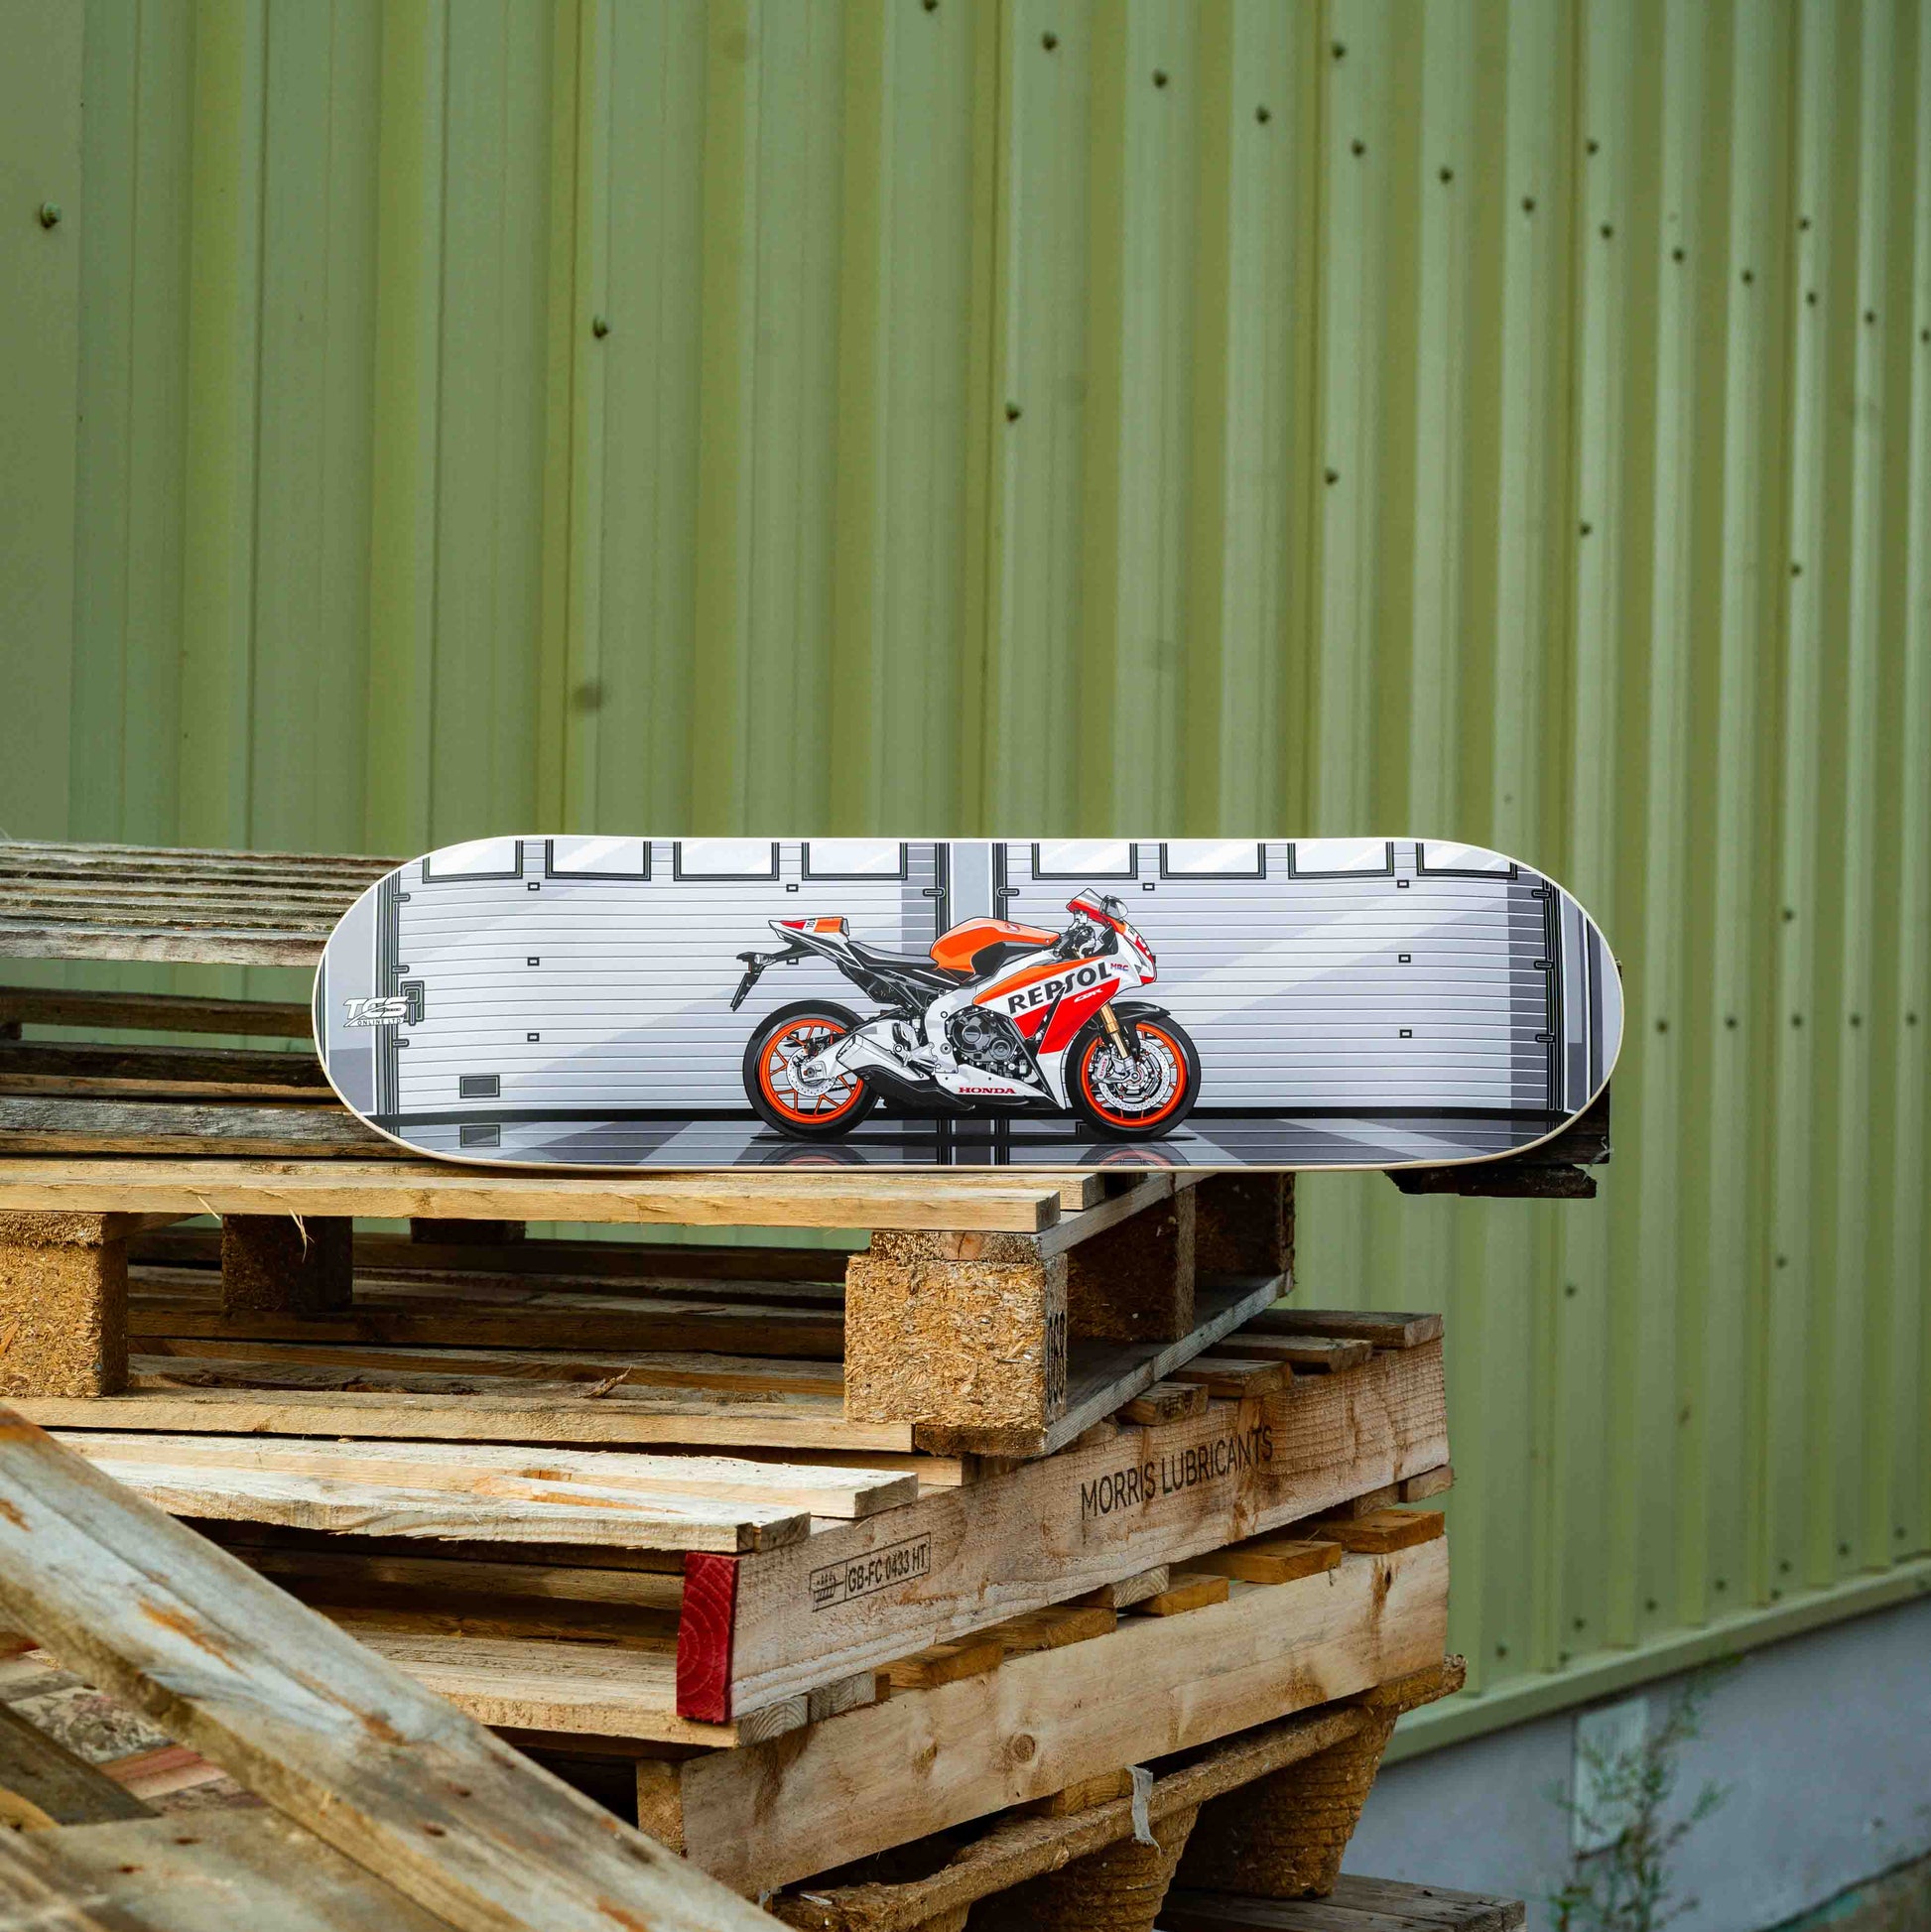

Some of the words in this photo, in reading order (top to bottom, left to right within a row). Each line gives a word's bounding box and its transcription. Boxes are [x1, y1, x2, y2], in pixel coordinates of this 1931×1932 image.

[1007, 962, 1112, 1014] REPSOL
[1110, 963, 1129, 971] HRC
[343, 996, 408, 1019] TCS
[1081, 1461, 1156, 1520] MORRIS
[1161, 1425, 1274, 1494] LUBRICANTS
[847, 1558, 883, 1593] GB-FC
[912, 1543, 927, 1571] HT
